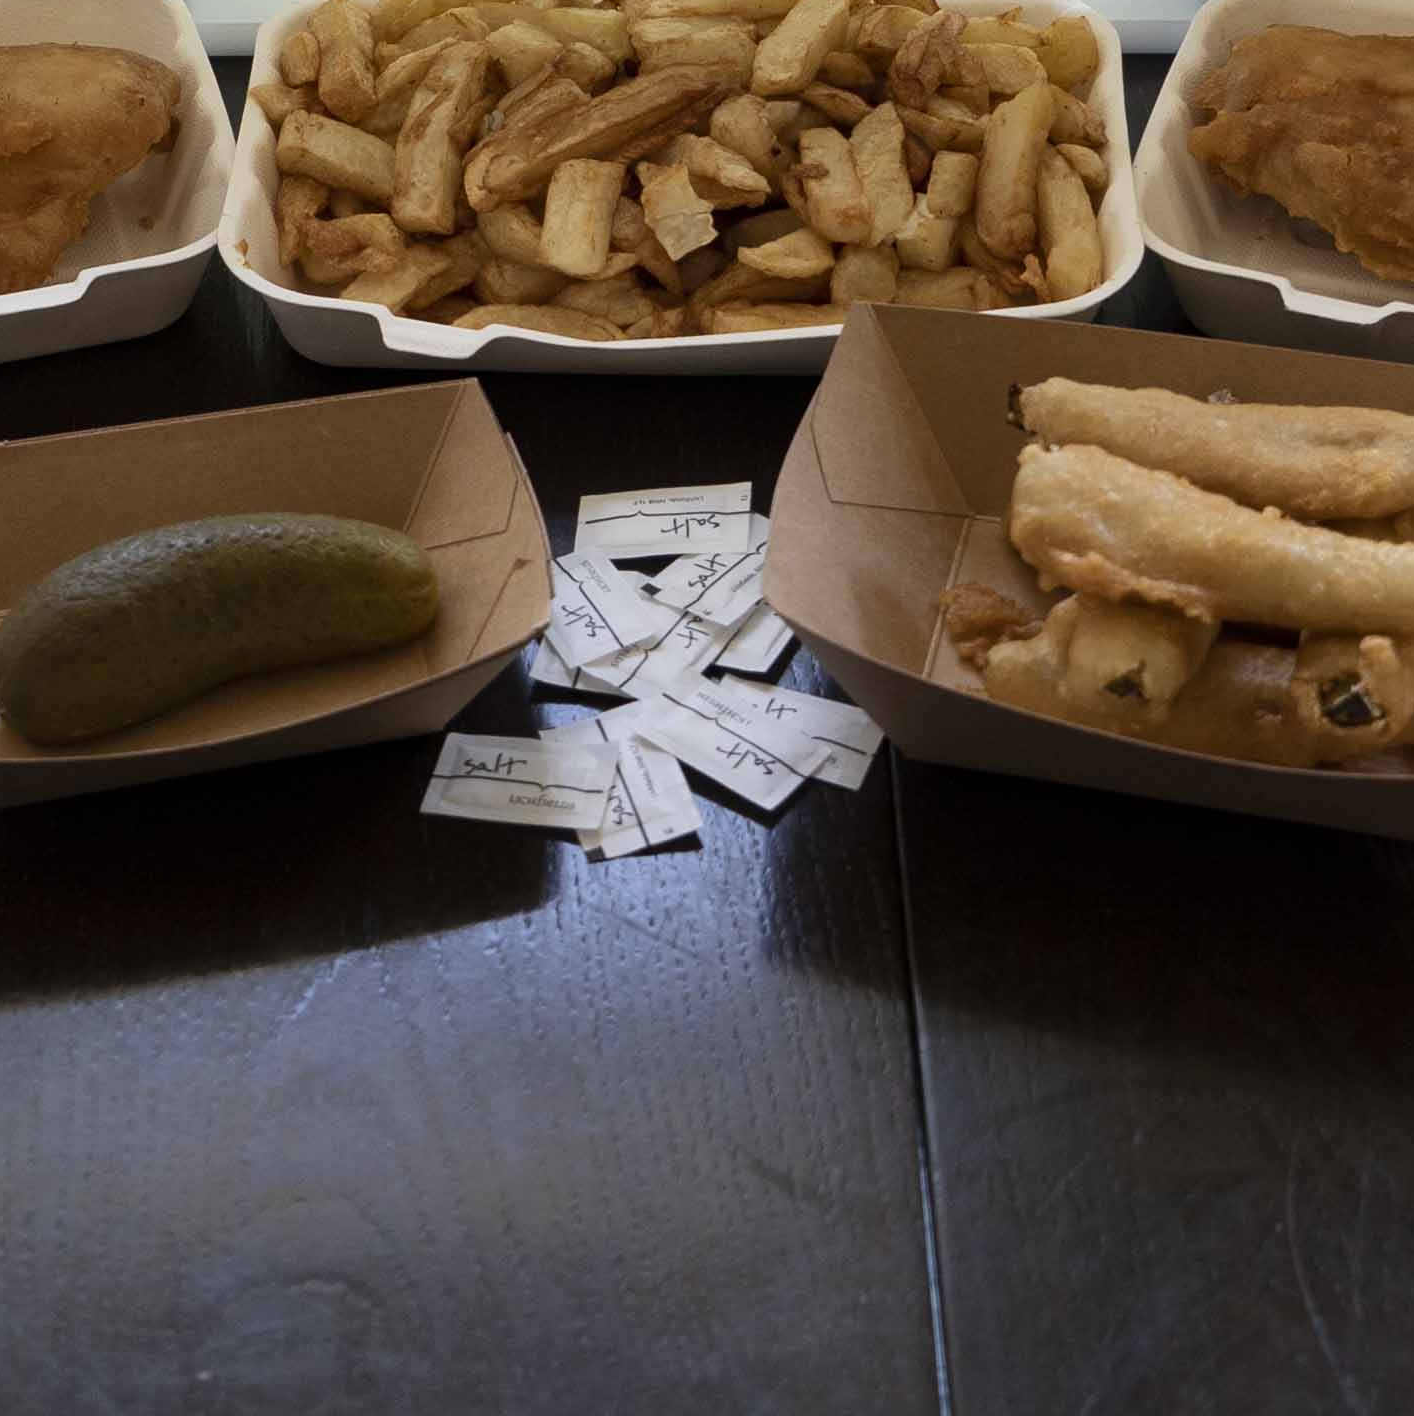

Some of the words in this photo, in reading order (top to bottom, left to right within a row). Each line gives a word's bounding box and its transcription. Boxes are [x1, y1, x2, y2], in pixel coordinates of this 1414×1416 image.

[660, 514, 721, 537] salt
[687, 552, 728, 591] salt
[561, 602, 598, 639] salt
[463, 753, 528, 776] salt
[715, 744, 778, 776] salt
